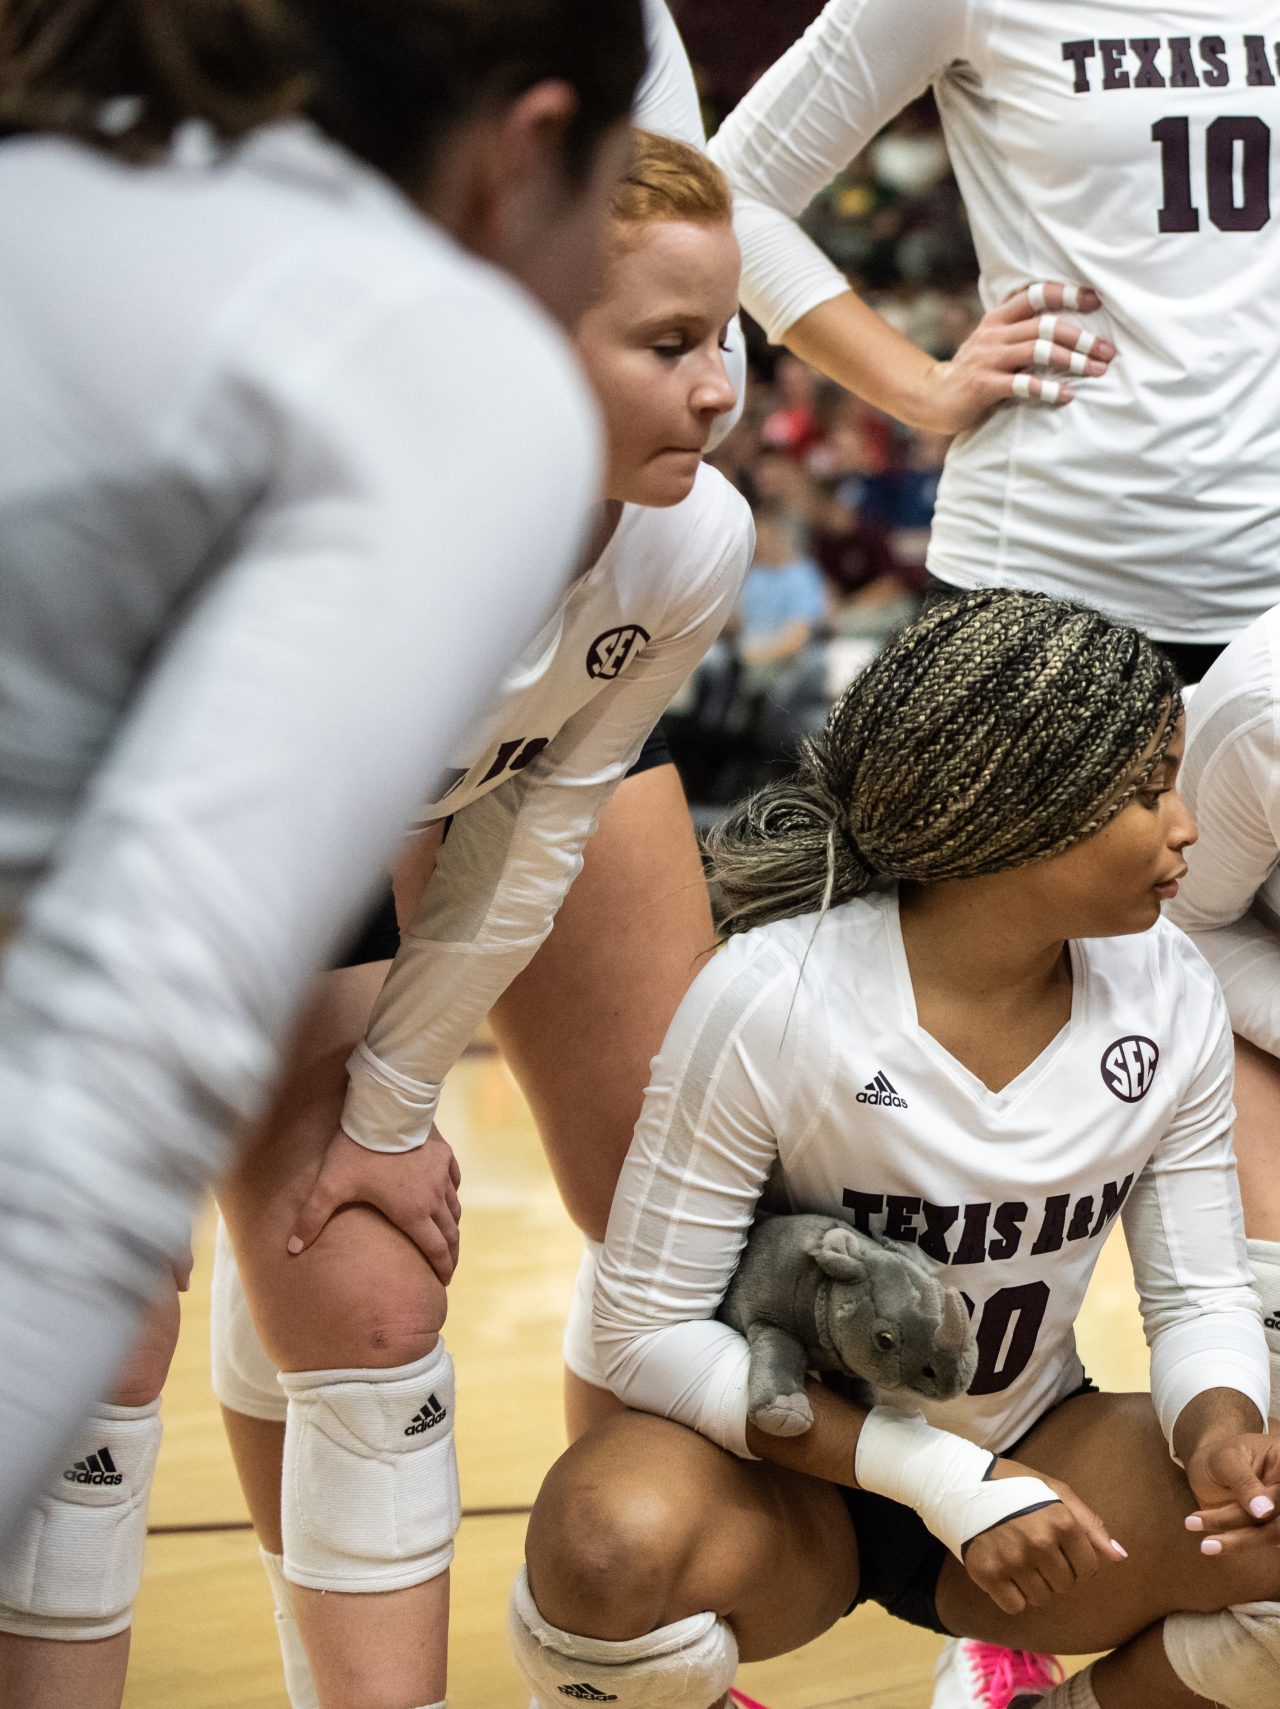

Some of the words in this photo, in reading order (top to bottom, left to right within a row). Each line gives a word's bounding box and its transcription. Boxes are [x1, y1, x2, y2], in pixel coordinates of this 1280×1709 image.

[1062, 36, 1230, 93] TEXAS
[1151, 116, 1271, 233] 10
[1105, 1040, 1157, 1098] SEC
[855, 1090, 908, 1109] adidas
[842, 1188, 1029, 1265] TEXAS
[1029, 1171, 1135, 1256] A&M
[959, 1280, 1050, 1396] 0
[404, 1408, 447, 1437] adidas
[63, 1469, 123, 1486] adidas
